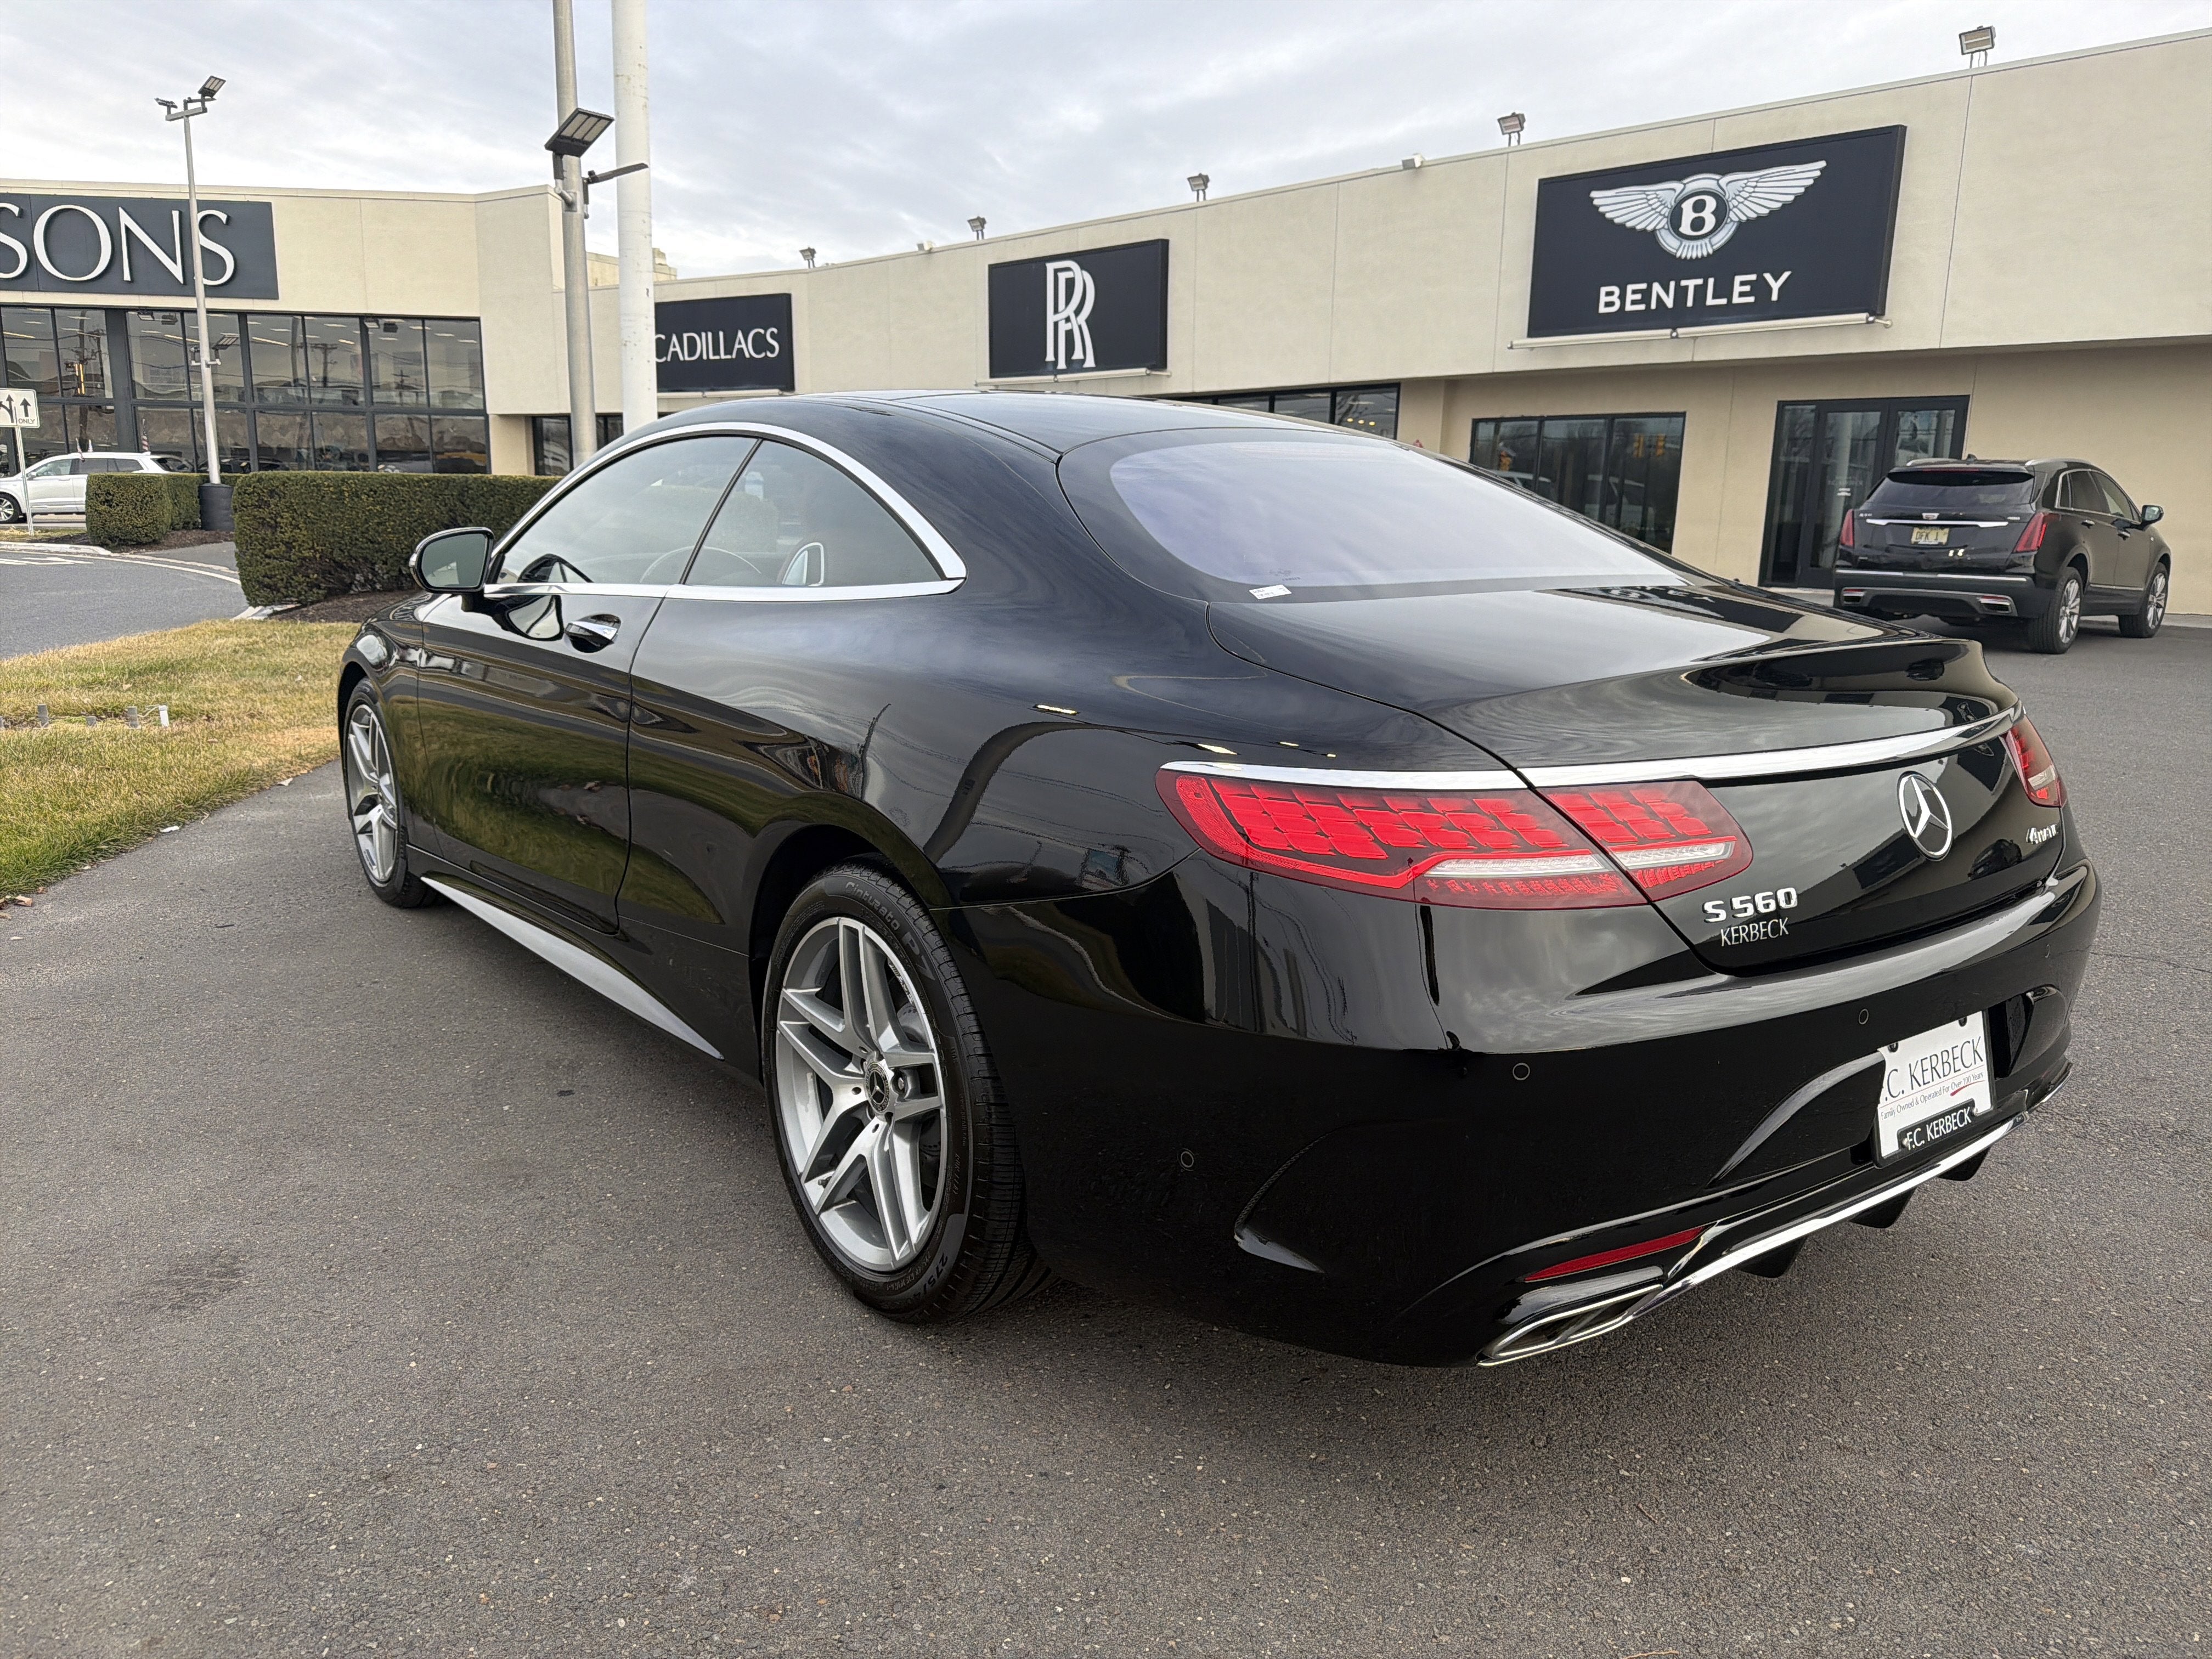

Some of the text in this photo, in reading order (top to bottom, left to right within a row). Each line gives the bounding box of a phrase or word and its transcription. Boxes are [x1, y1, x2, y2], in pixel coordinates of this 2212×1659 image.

[0, 202, 235, 285] SONS
[1598, 270, 1792, 314] BENTLEY
[655, 327, 780, 363] CADILLACS
[845, 881, 900, 931] Cinturato
[1703, 887, 1798, 923] S 560
[1720, 917, 1789, 947] KERBECK
[1885, 1036, 1984, 1102] .C. KERBECK
[1881, 1107, 1896, 1120] Family
[1896, 1098, 1915, 1114] Owned
[1915, 1098, 1920, 1106] &
[1920, 1087, 1942, 1104] Operated
[1951, 1080, 1962, 1090] Over
[1963, 1075, 1972, 1085] 100
[1972, 1071, 1984, 1081] Years
[1905, 1106, 1972, 1150] F.C. KERBECK
